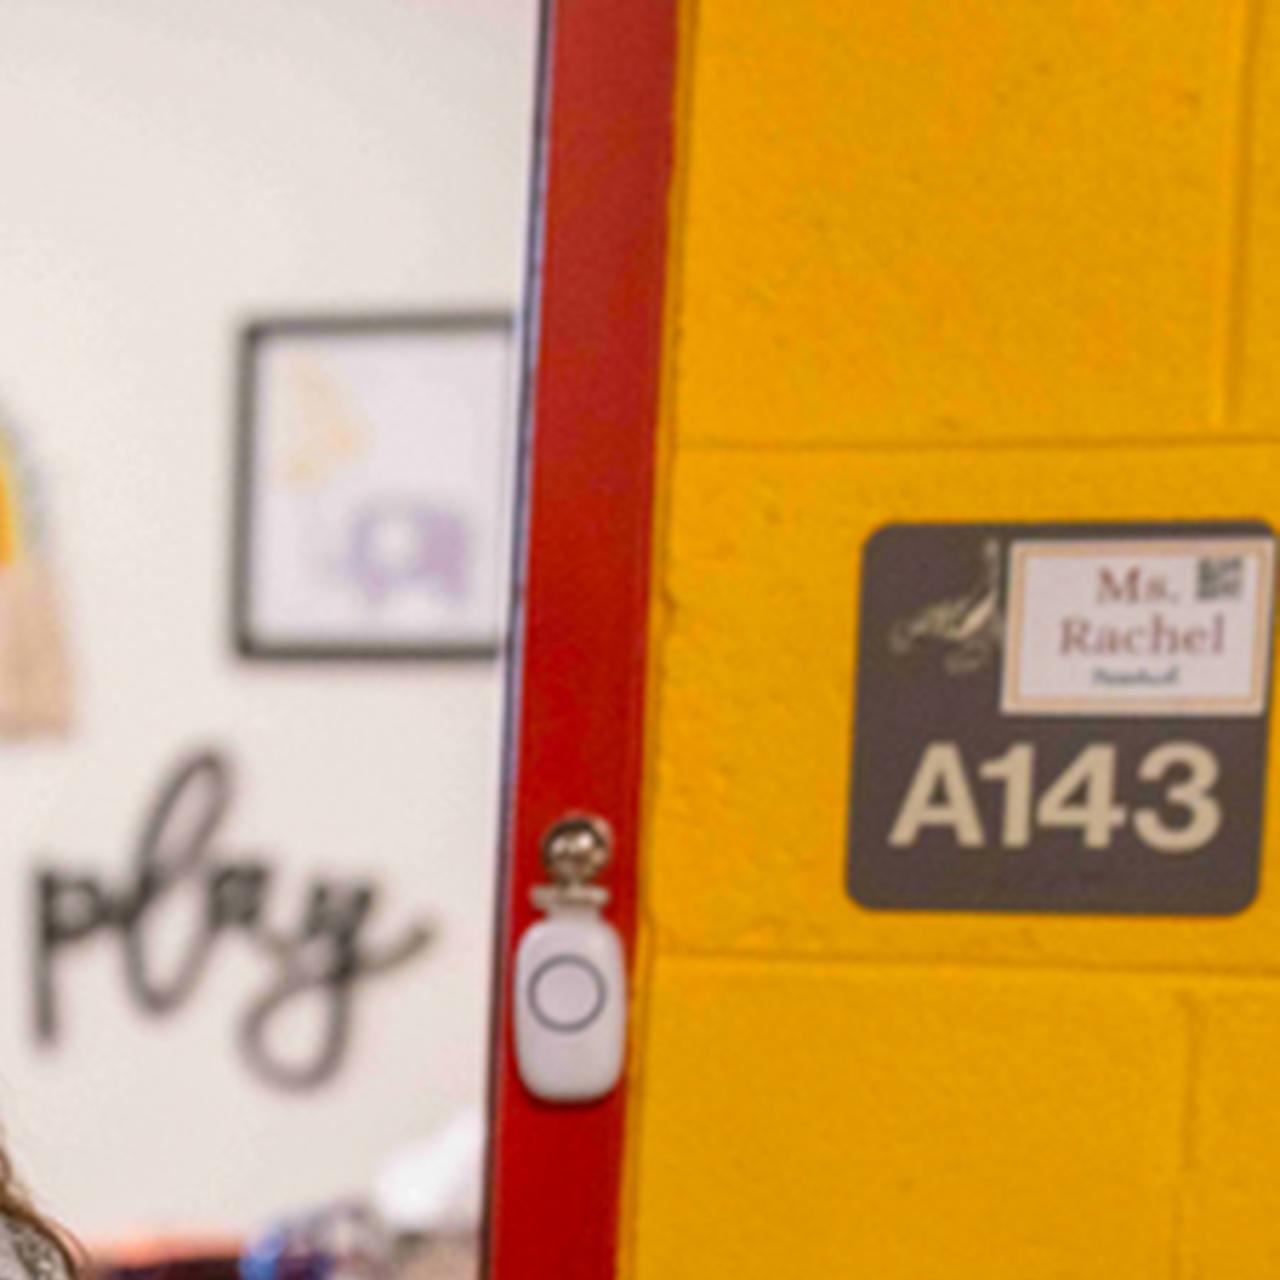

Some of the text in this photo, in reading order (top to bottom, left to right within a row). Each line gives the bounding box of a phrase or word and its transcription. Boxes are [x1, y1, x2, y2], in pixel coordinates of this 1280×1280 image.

[1095, 565, 1181, 604] Ms.
[1058, 613, 1227, 656] Rachel
[888, 740, 1222, 854] A143
[32, 745, 438, 1094] play
